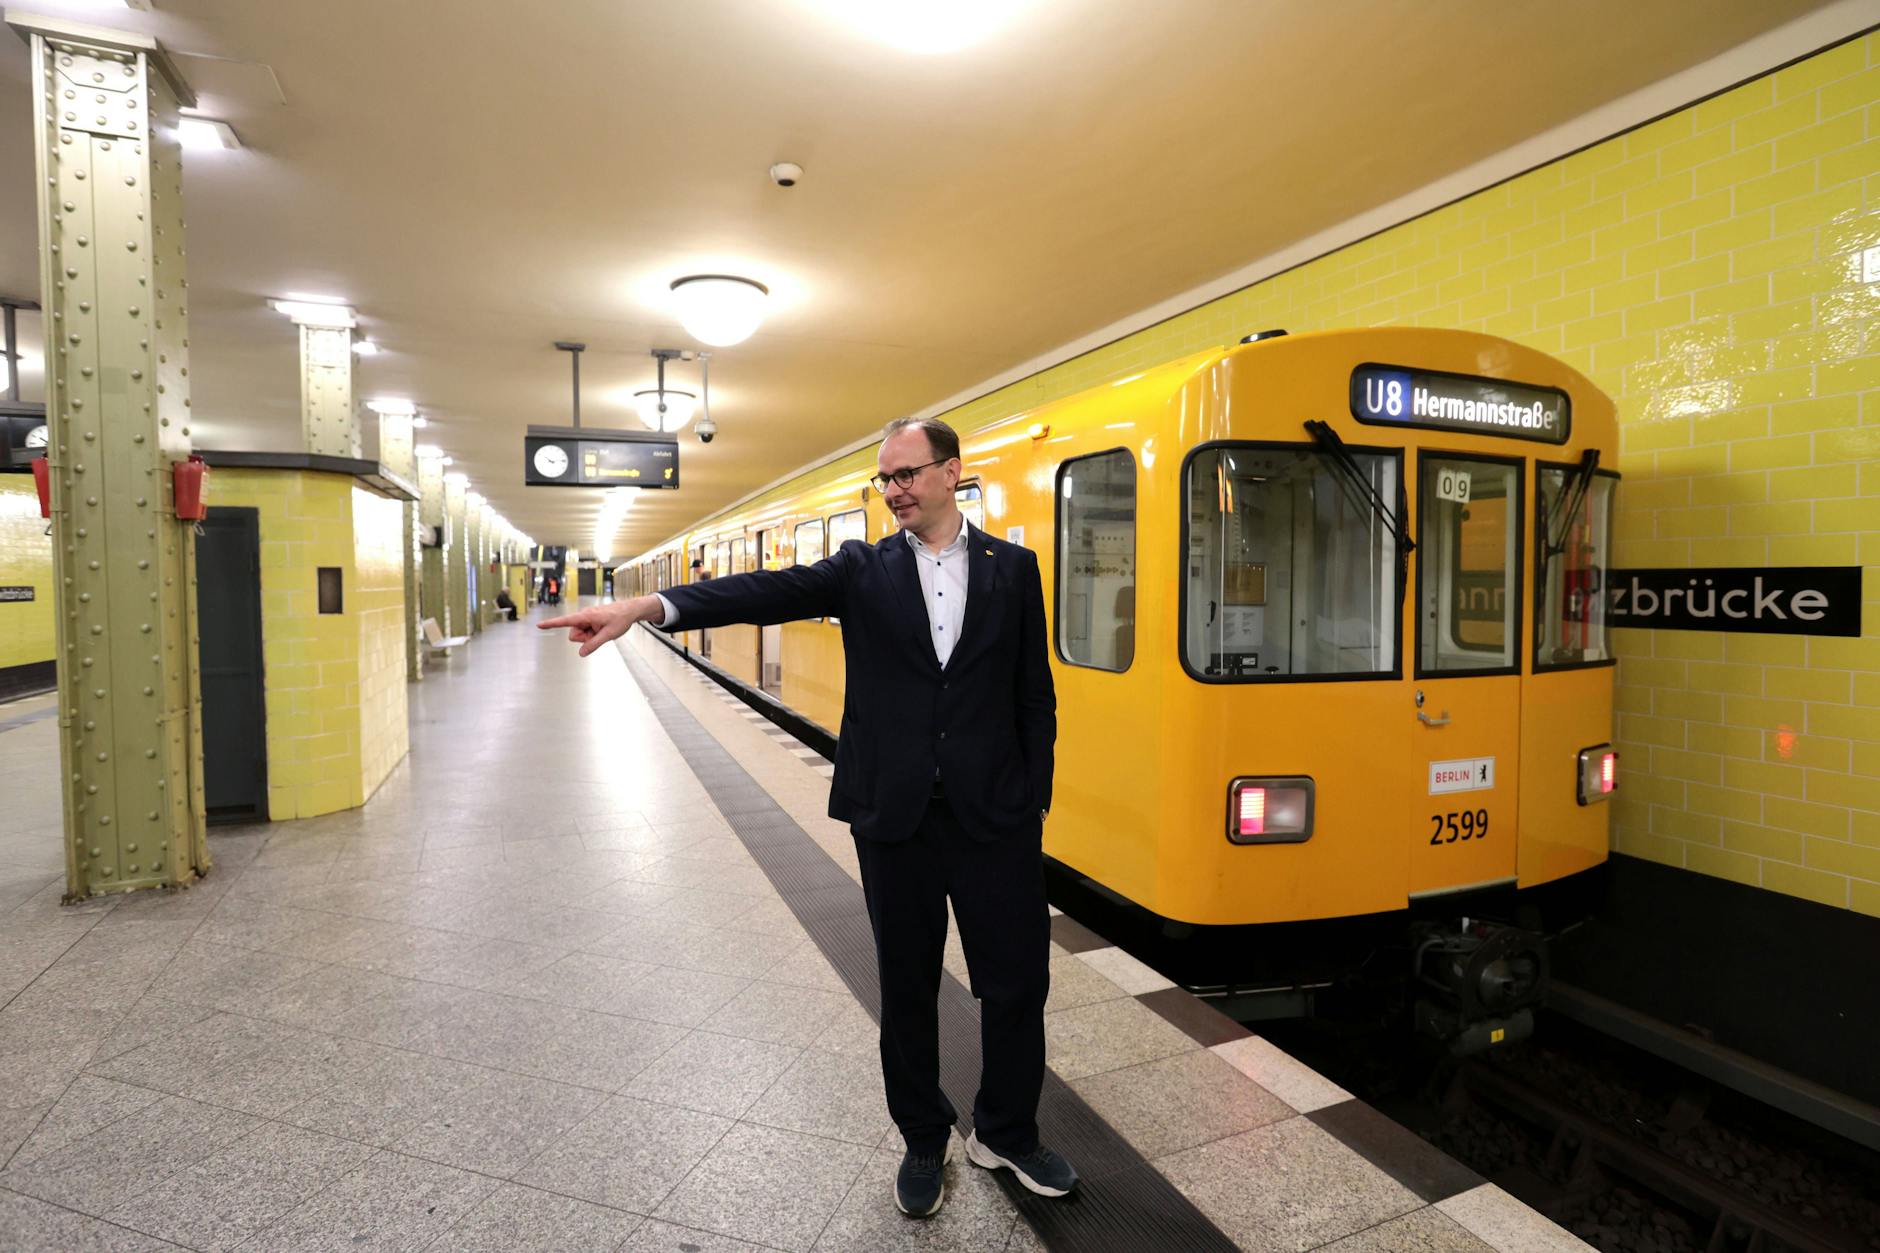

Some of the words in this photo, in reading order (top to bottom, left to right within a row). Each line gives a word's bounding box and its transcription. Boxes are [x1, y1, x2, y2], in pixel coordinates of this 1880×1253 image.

[1366, 377, 1403, 416] U8
[1413, 387, 1554, 430] Hermannstraße
[1443, 476, 1467, 498] 09
[1610, 576, 1829, 621] zbrücke
[1435, 769, 1470, 784] BERLIN
[1430, 808, 1489, 846] 2599
